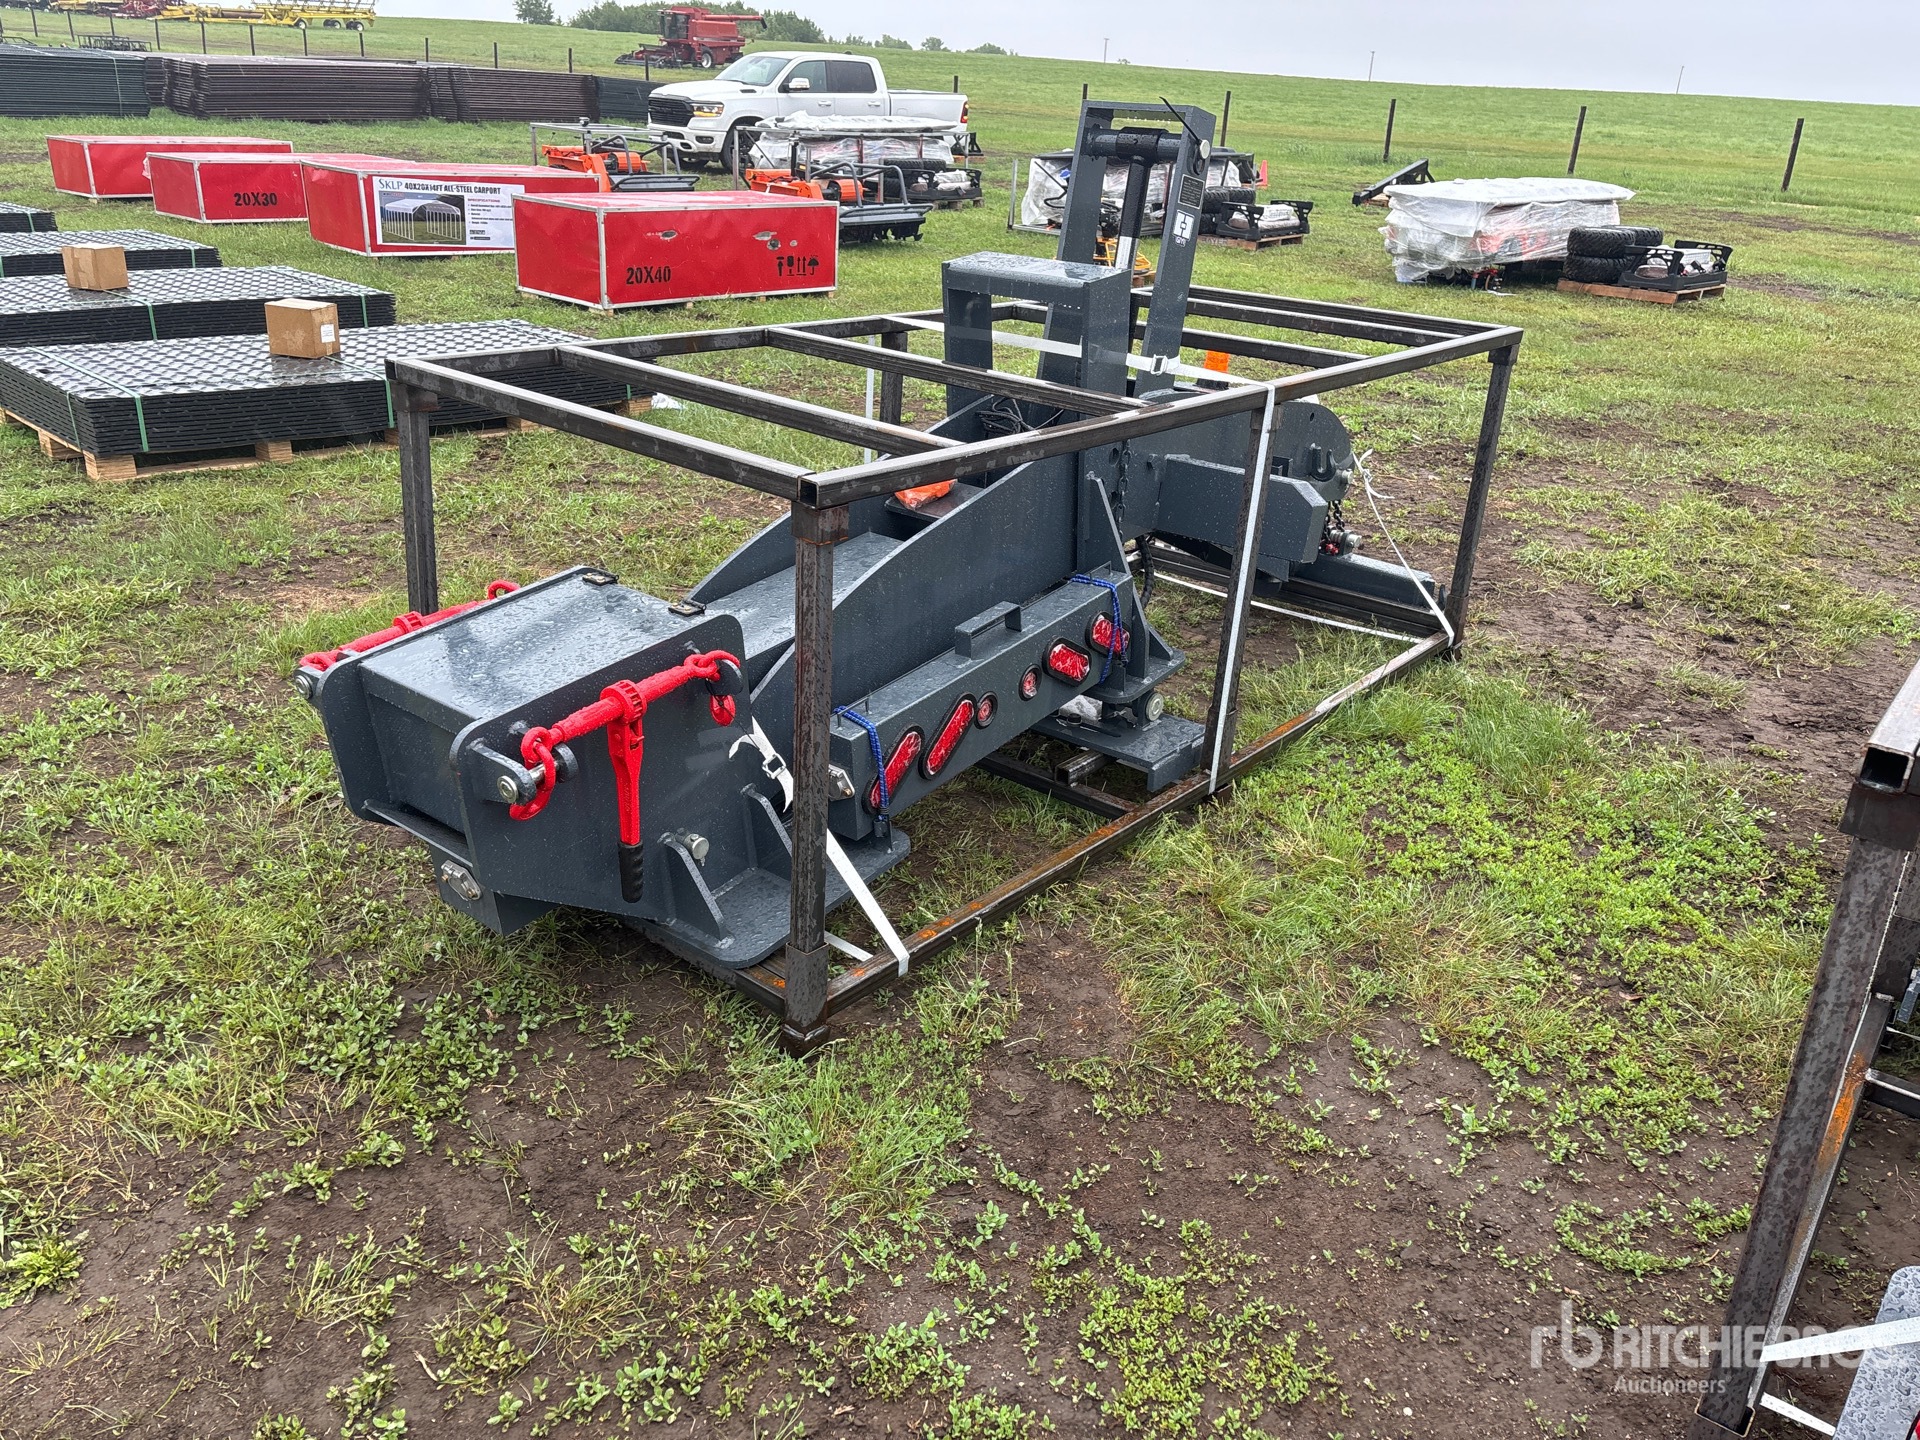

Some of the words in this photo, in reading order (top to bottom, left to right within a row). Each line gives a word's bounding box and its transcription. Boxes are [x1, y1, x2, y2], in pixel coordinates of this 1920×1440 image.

[379, 178, 403, 190] SKLP
[443, 185, 473, 194] ALL-STEEL
[473, 186, 501, 195] CARPORT
[233, 191, 278, 207] 20X30
[626, 266, 672, 285] 20X40
